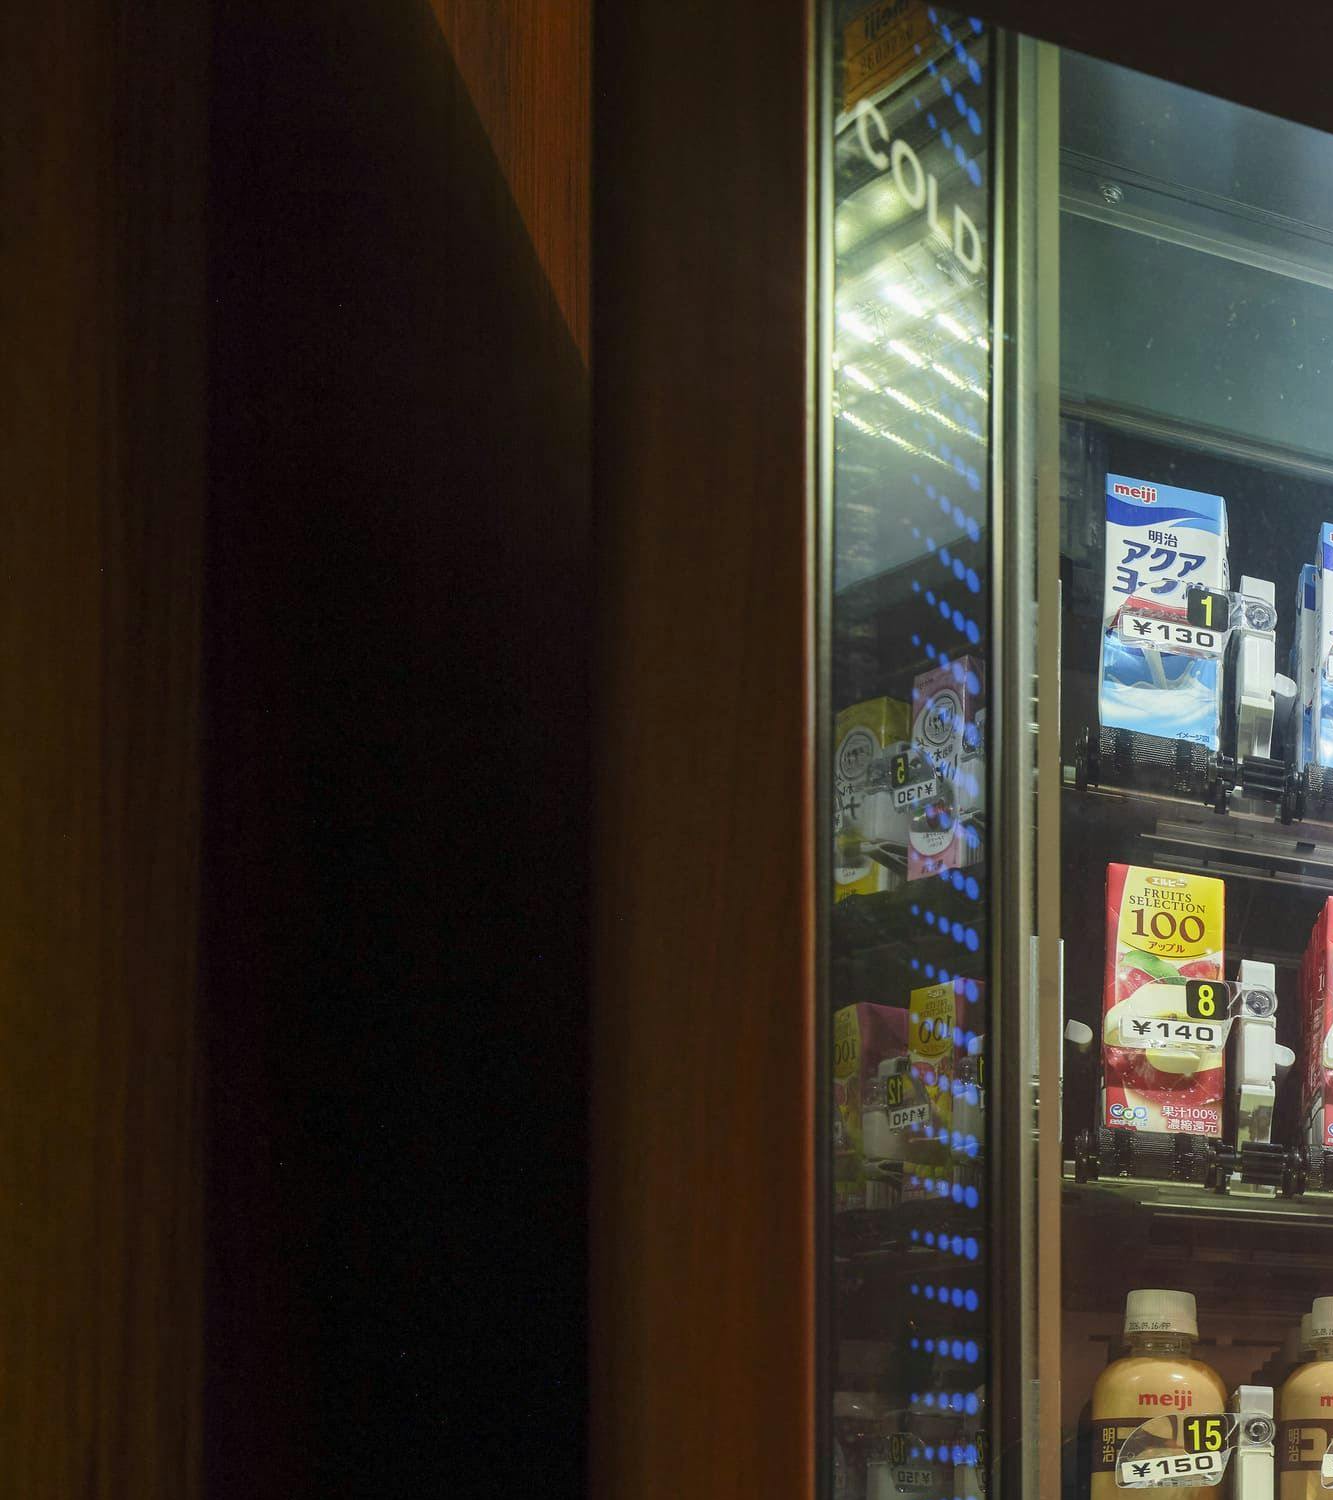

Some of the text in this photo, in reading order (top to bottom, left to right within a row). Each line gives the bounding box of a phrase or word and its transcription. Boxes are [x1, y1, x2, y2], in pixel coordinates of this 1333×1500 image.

[856, 99, 983, 273] COLD
[1114, 484, 1157, 503] meiji
[1148, 530, 1178, 548] 明治
[1121, 539, 1206, 577] アクア
[1201, 595, 1213, 627] 1
[1133, 619, 1214, 649] ¥130
[1129, 895, 1206, 914] SELECTION
[1144, 888, 1191, 903] FRUITS
[1131, 908, 1206, 944] 100
[1148, 940, 1185, 954] アップル
[1198, 984, 1214, 1016] 8
[1132, 1020, 1214, 1042] ¥140
[1161, 1105, 1218, 1120] 果汁100%
[1167, 1118, 1217, 1133] 濃縮還元
[1138, 1389, 1193, 1410] meiji
[1188, 1420, 1222, 1450] 15
[1131, 1455, 1213, 1478] ¥150
